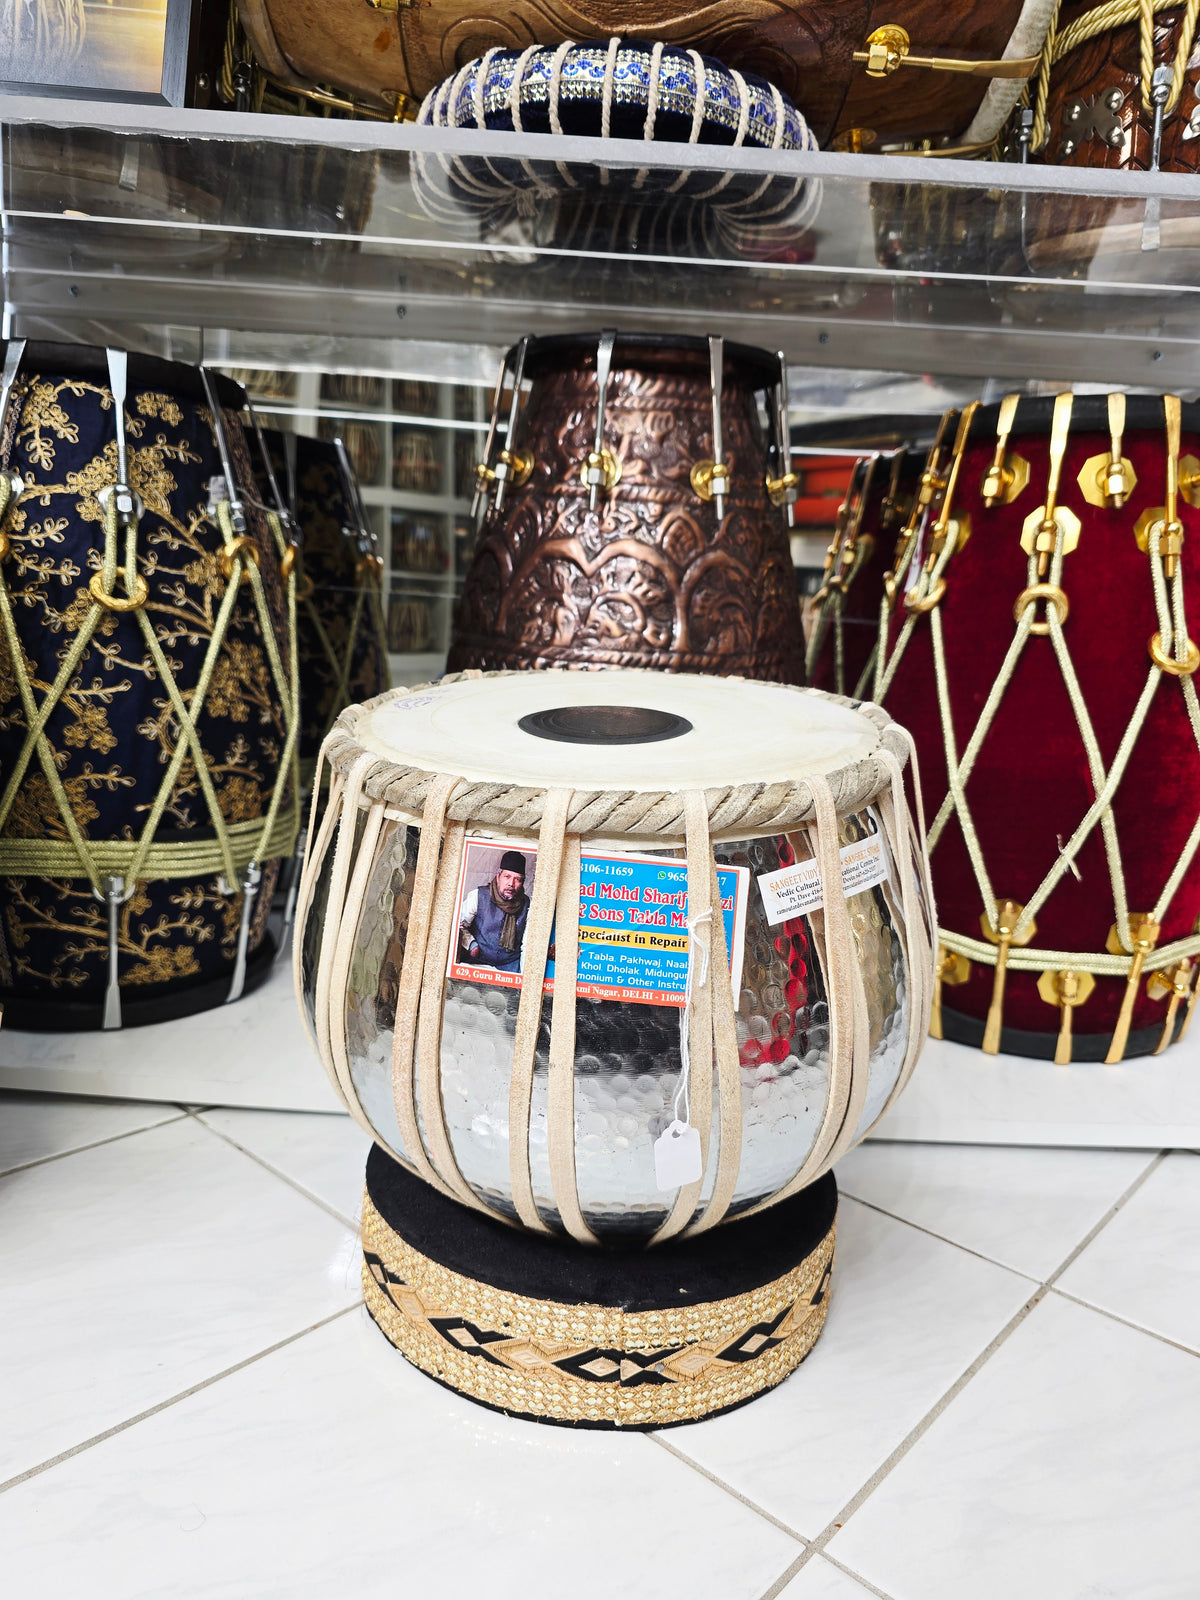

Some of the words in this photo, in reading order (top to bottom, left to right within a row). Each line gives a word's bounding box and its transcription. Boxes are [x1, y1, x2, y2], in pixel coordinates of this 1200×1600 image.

[769, 873, 803, 892] SANGEET
[776, 888, 795, 899] Vedic
[795, 878, 820, 893] Cultural
[599, 883, 640, 901] Mohd
[642, 887, 688, 910] Sharif
[797, 891, 811, 901] Dave
[588, 904, 624, 922] Sons
[628, 908, 667, 926] Tabla
[634, 934, 646, 945] in
[455, 968, 471, 978] 629,
[472, 970, 493, 980] Guru
[495, 973, 515, 983] Ram
[592, 986, 620, 997] Nagar,
[622, 989, 654, 1000] DELHI
[577, 973, 613, 983] monium
[616, 976, 625, 984] &
[627, 977, 655, 987] Other
[658, 979, 686, 990] Instru
